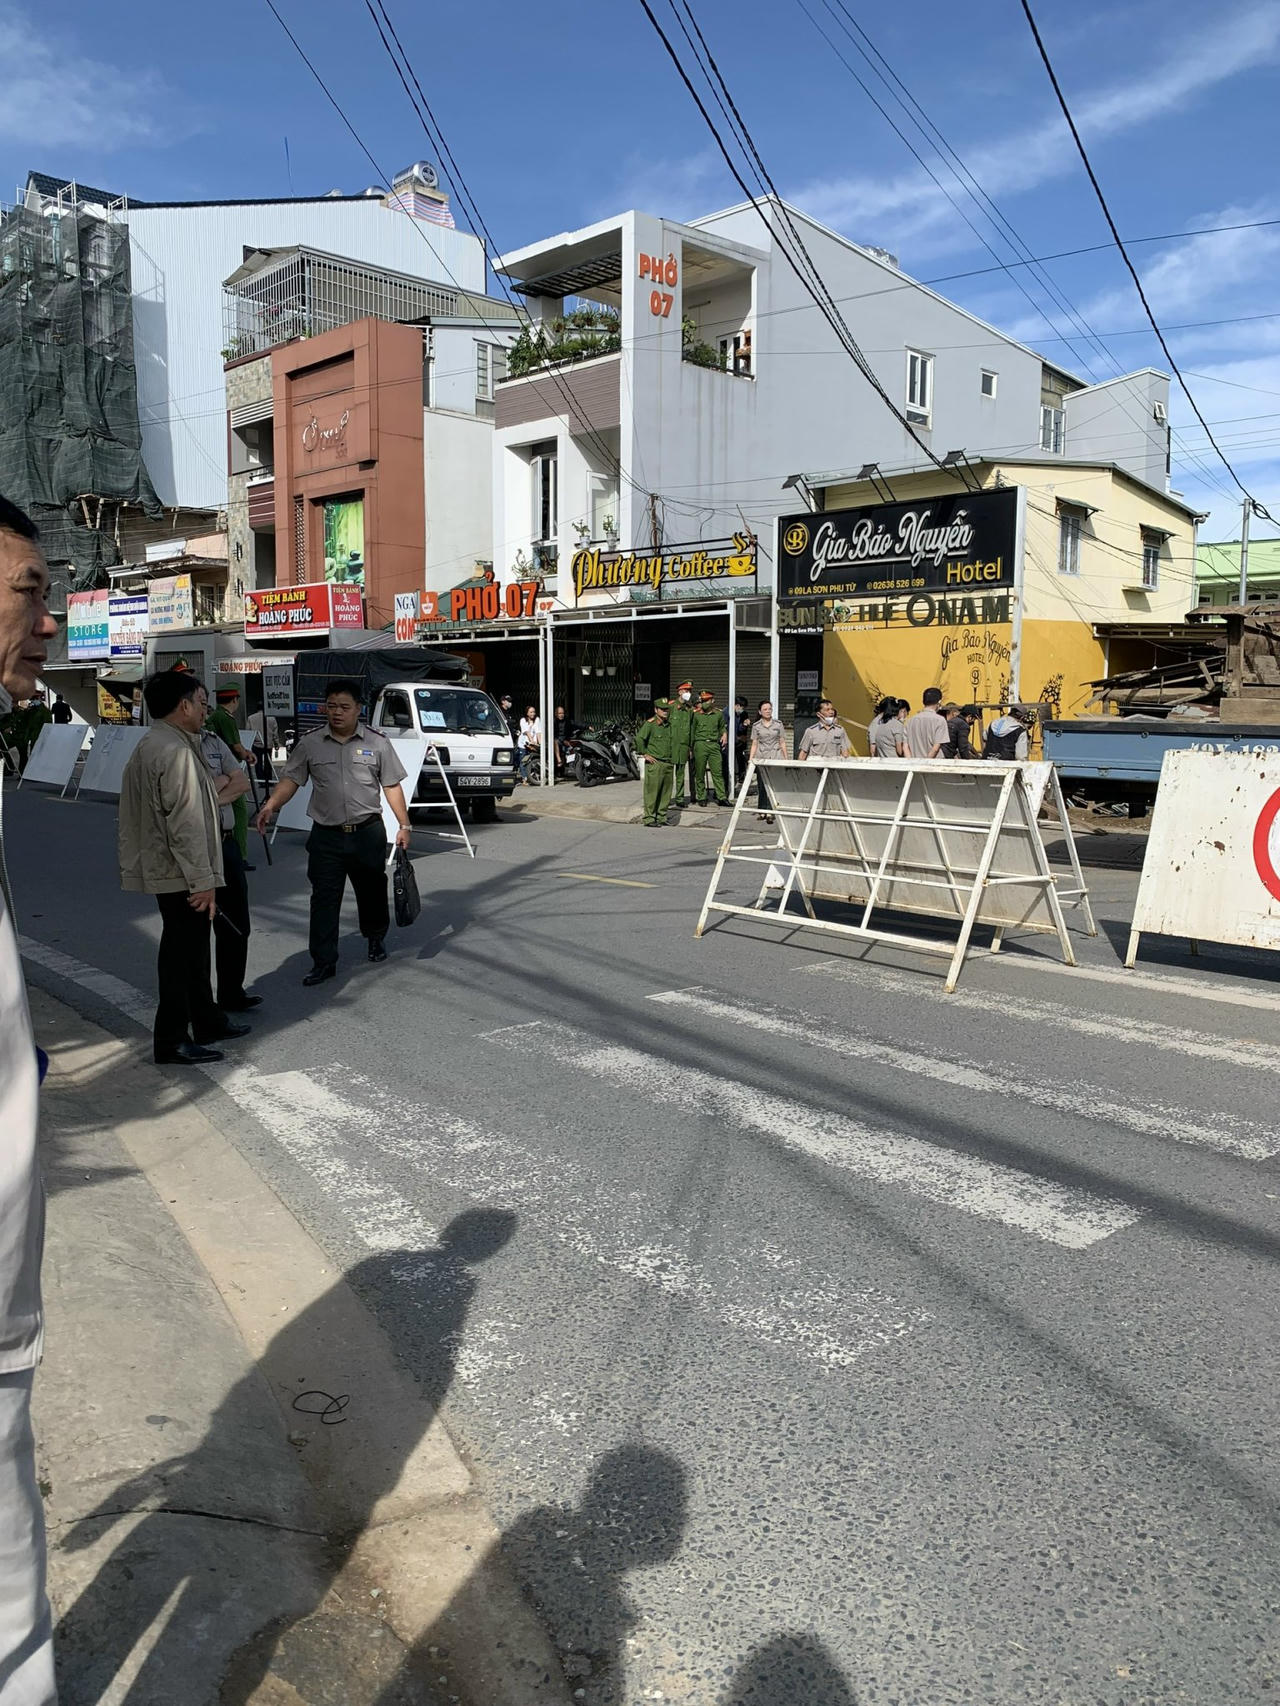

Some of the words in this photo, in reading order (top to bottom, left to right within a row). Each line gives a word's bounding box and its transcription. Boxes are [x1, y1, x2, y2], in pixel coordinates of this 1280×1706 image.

[638, 252, 679, 287] PHỞ
[650, 290, 674, 318] 07
[810, 521, 849, 582] Gia
[848, 519, 893, 560] Bảo
[895, 509, 975, 567] Nguyễn
[668, 552, 723, 578] Coffee
[946, 557, 1003, 585] Hotel
[282, 588, 306, 602] BÁNH
[450, 570, 501, 623] PHỞ
[505, 581, 540, 619] 07
[803, 586, 812, 594] LA
[829, 585, 845, 593] PHU
[259, 606, 287, 625] HOÀNG
[288, 604, 312, 623] PHÚC
[335, 603, 360, 612] HOÀNG
[338, 612, 358, 621] PHÚC
[539, 601, 553, 611] 07
[74, 624, 103, 637] STORE
[941, 635, 959, 671] Gia
[967, 652, 985, 665] HOTEL
